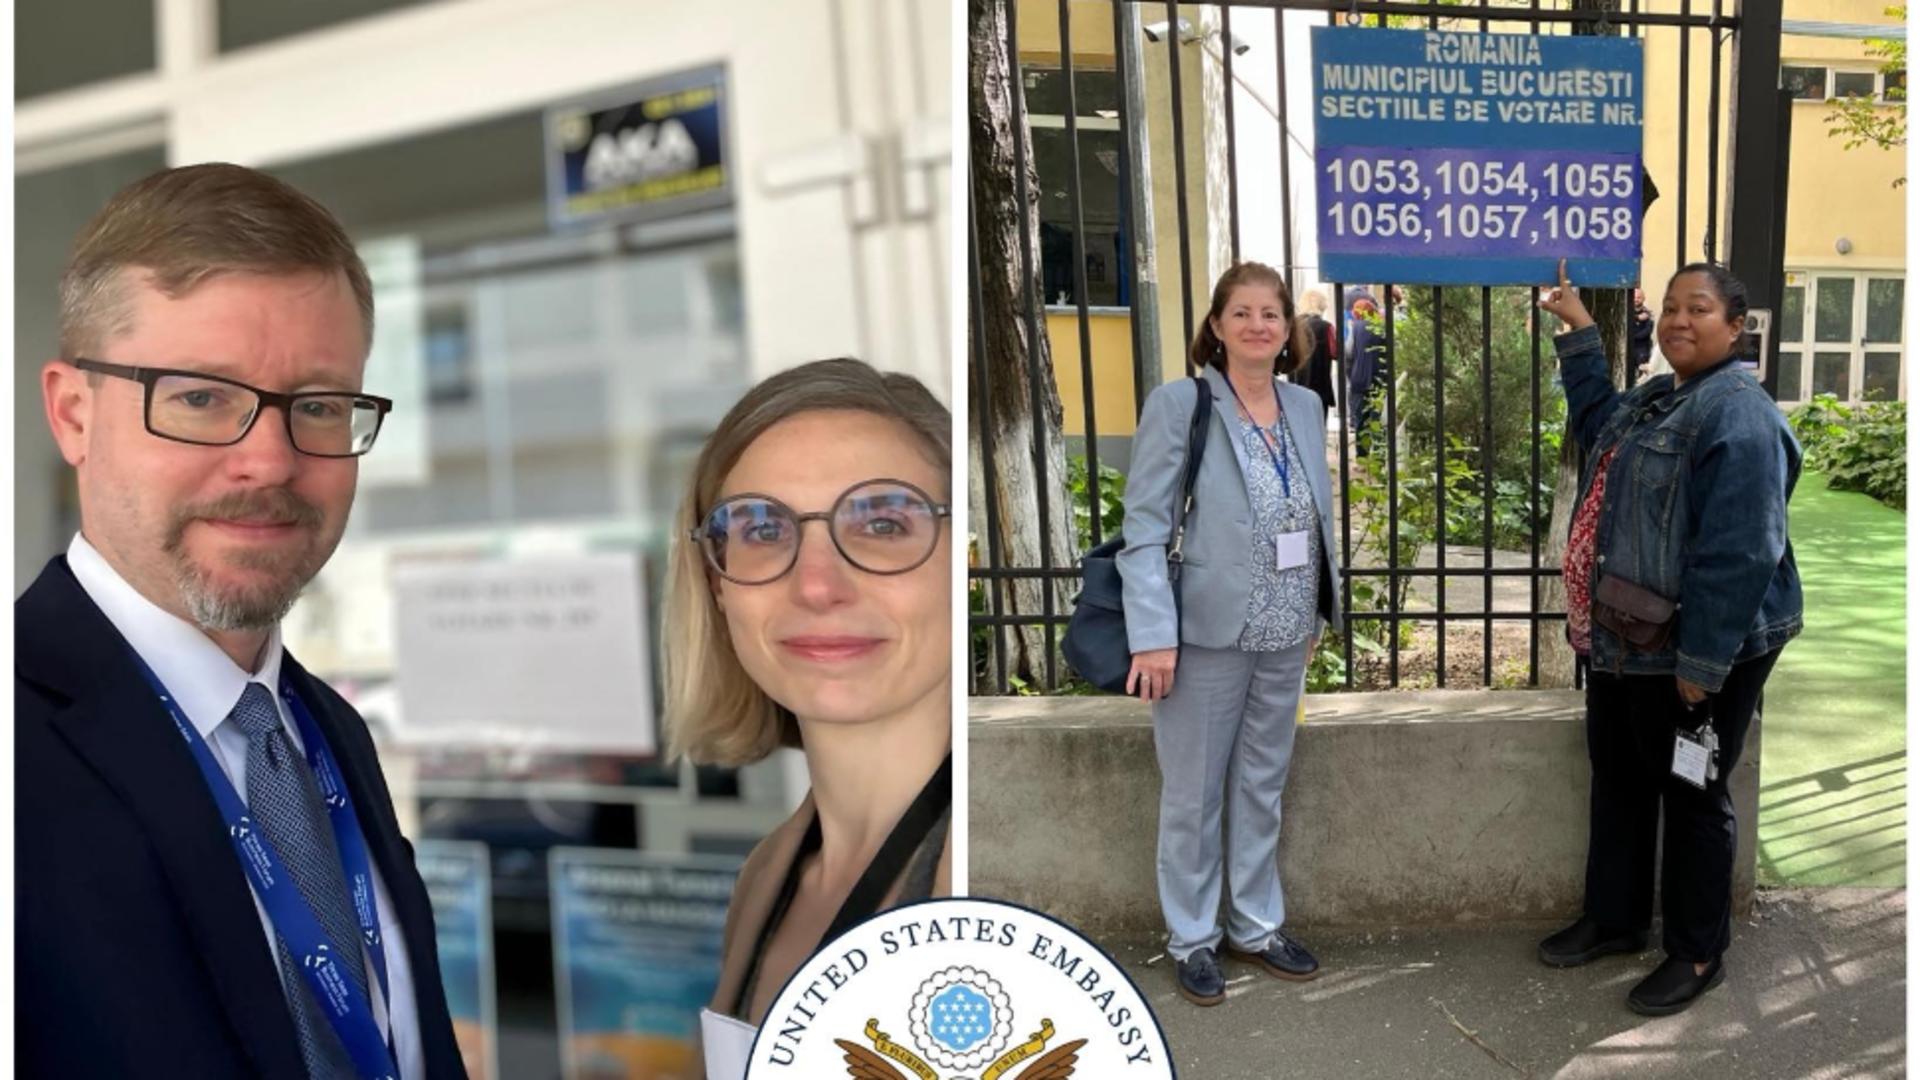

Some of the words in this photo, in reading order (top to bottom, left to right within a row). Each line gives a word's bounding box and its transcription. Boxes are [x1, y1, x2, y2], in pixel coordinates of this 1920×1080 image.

[1426, 33, 1542, 66] ROMANIA
[1323, 64, 1473, 95] MUNICIPIUL
[1482, 69, 1632, 97] BUCURESTI
[1321, 96, 1445, 121] SECTIILE
[1455, 100, 1489, 122] DE
[1498, 100, 1595, 124] VOTARE
[1603, 102, 1643, 126] NR.
